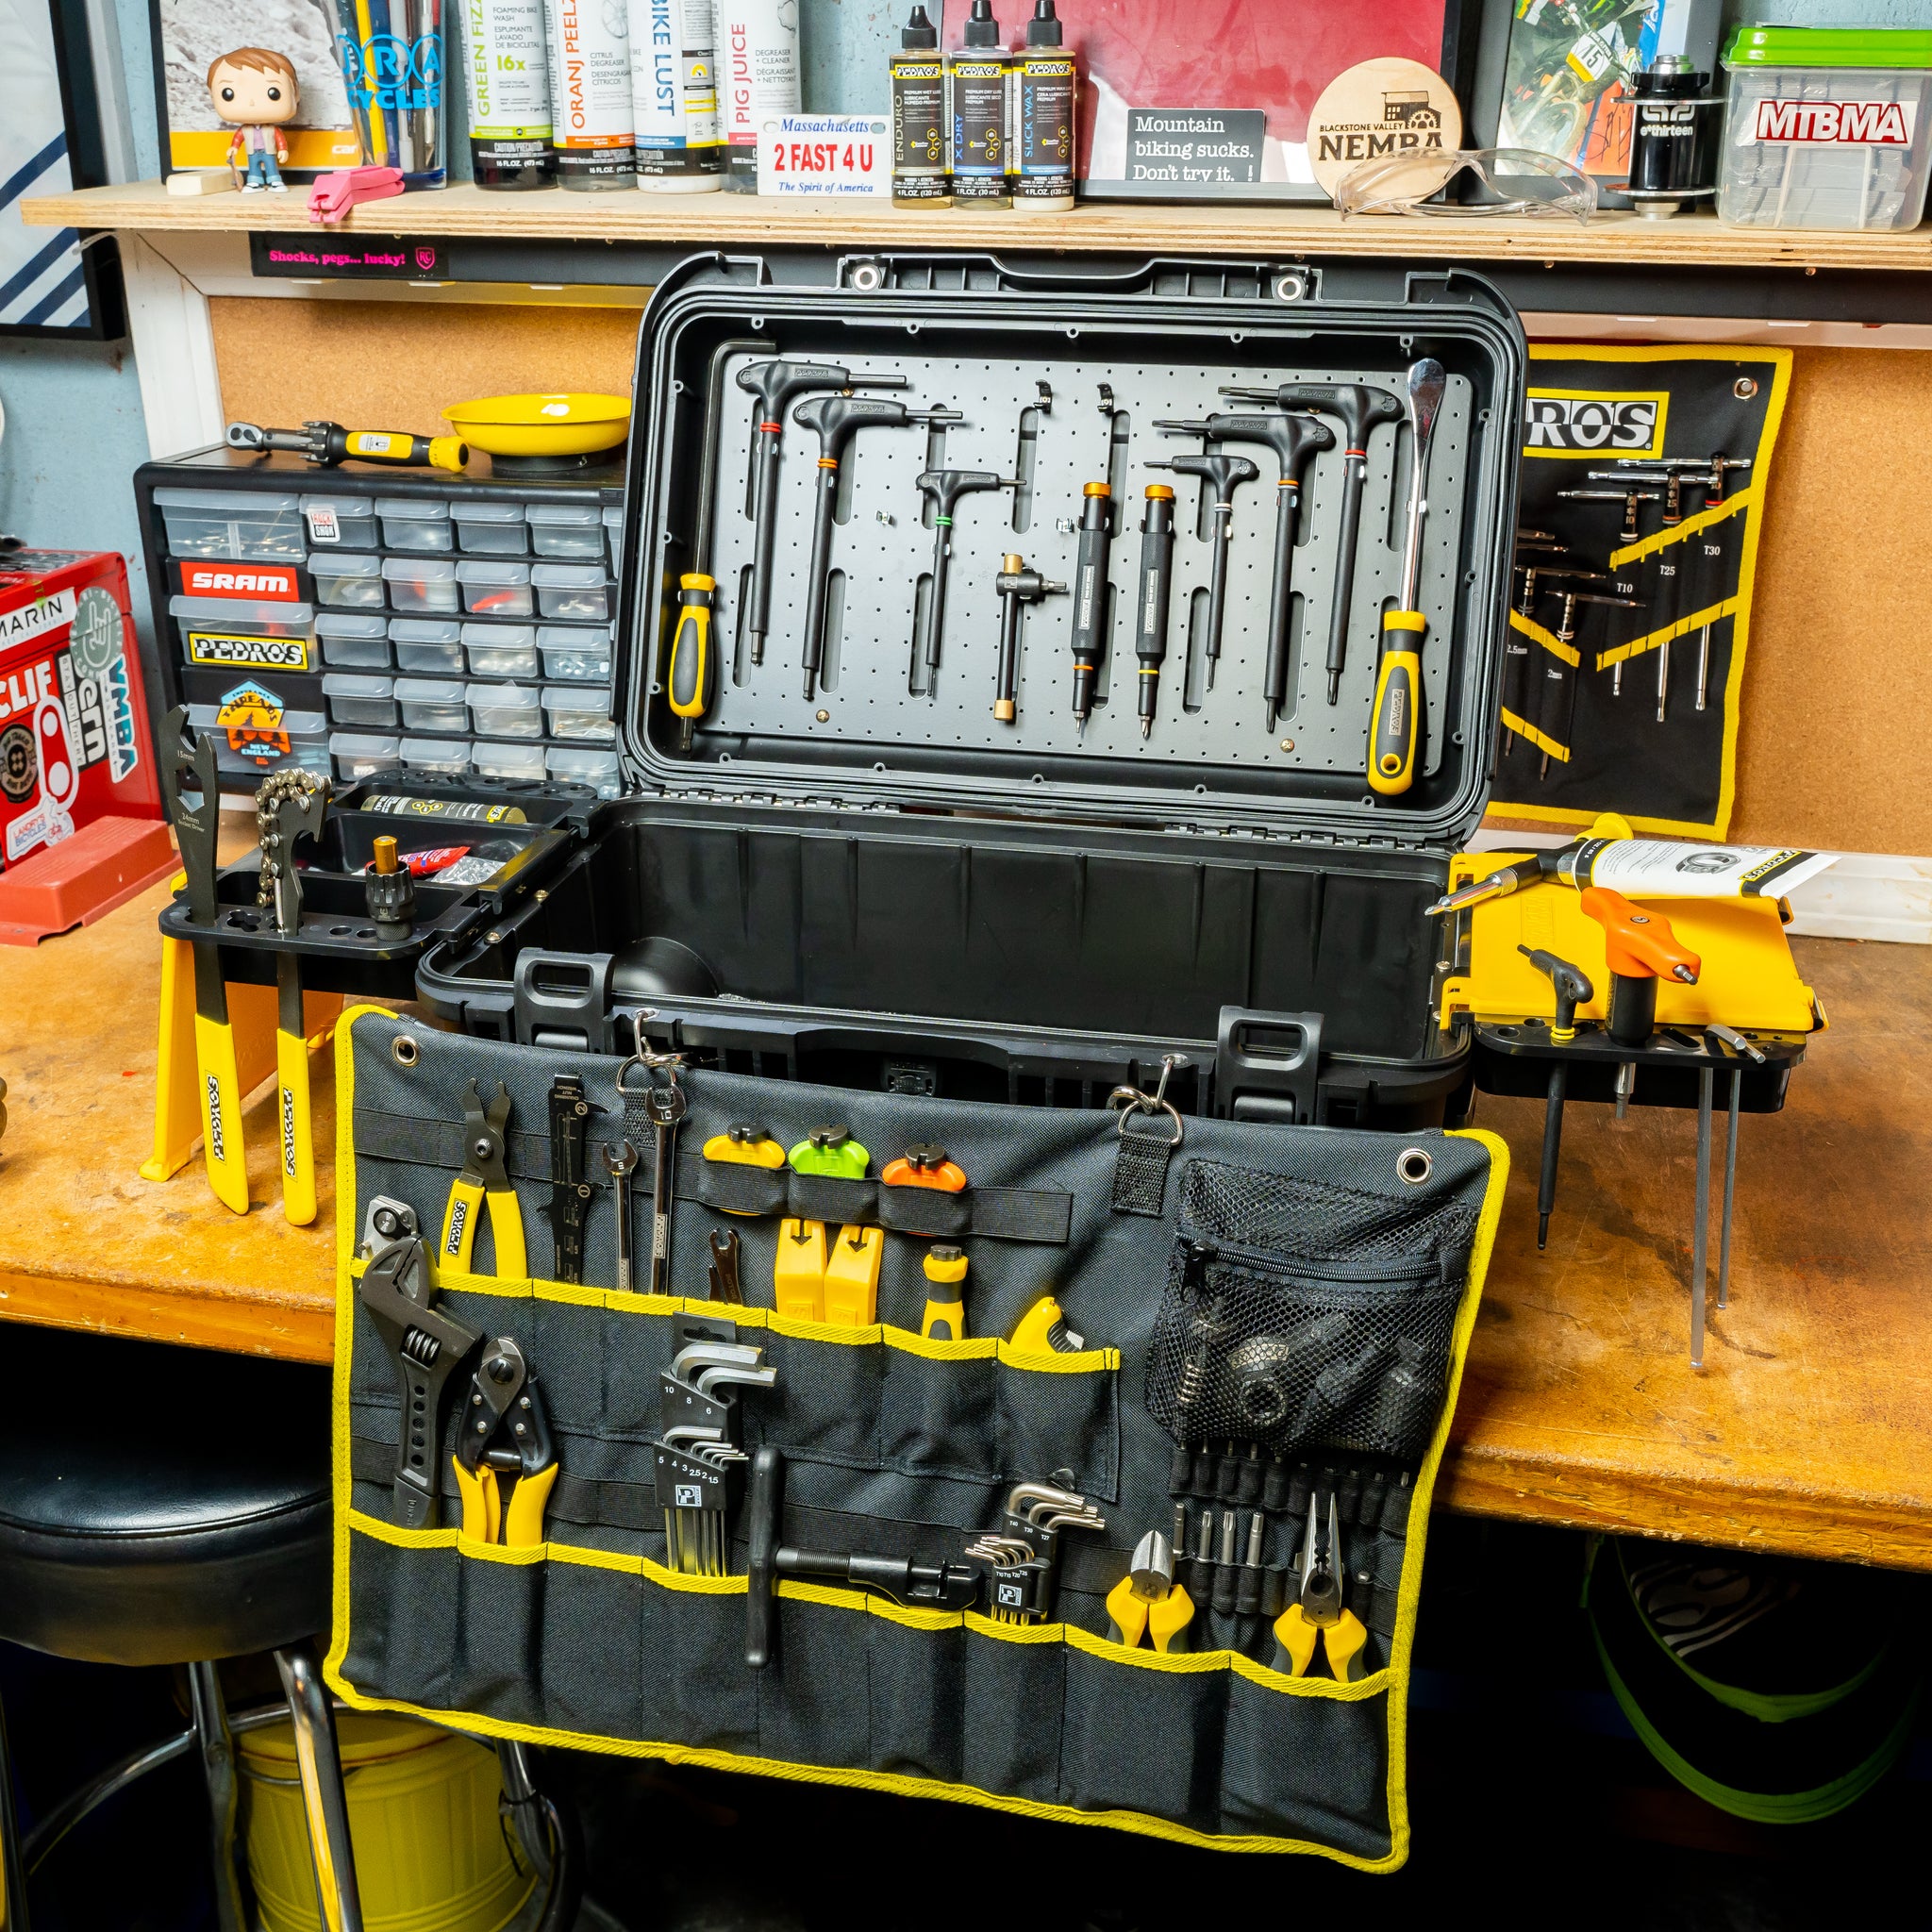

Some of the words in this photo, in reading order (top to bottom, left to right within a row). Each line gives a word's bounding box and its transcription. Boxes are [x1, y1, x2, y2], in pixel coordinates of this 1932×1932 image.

[562, 0, 580, 53] PEEL
[342, 46, 441, 75] JRA
[731, 24, 753, 83] JUICE
[1580, 44, 1603, 68] 15
[474, 44, 491, 116] GREEN
[655, 54, 675, 116] LUST
[347, 89, 441, 109] CYCLES
[567, 60, 586, 129] ORANJ
[735, 90, 751, 124] PIG
[1024, 85, 1033, 118] WAX
[780, 119, 870, 133] Massachusetts
[895, 95, 904, 161] ENDURO
[955, 115, 963, 144] DRY
[1135, 116, 1225, 133] Mountain
[1320, 125, 1372, 133] BLACKSTONE
[1373, 123, 1404, 132] VALLEY
[1756, 100, 1908, 144] MTBMA
[1024, 122, 1033, 158] SLICK
[1135, 141, 1192, 159] biking
[1196, 141, 1255, 158] sucks.
[774, 143, 785, 172] 2
[791, 143, 838, 172] FAST
[842, 143, 854, 172] 4
[859, 143, 873, 173] U
[955, 149, 963, 160] X
[1133, 165, 1181, 181] Don't
[1183, 166, 1214, 182] try
[1216, 166, 1235, 181] it.
[778, 182, 795, 192] The
[798, 182, 823, 193] Spirit
[824, 183, 835, 193] of
[837, 183, 874, 192] America
[269, 250, 320, 265] Shocks,
[321, 253, 362, 266] pegs...
[364, 252, 406, 266] lucky!
[1526, 398, 1657, 449] RO'S
[1704, 545, 1720, 555] T30
[192, 573, 289, 592] SRAM
[1660, 566, 1675, 575] T25
[1617, 583, 1633, 593] T10
[194, 638, 303, 665] PEDRO'S
[0, 660, 52, 719] CLIF
[68, 693, 76, 717] OUT
[109, 658, 135, 776] VMBA
[222, 695, 277, 722] THREADS
[77, 677, 106, 763] ern
[177, 749, 195, 762] 15mm
[182, 812, 200, 824] 24mm
[207, 1074, 225, 1162] PEDRO'S
[661, 1110, 672, 1120] 10
[283, 1087, 296, 1178] PEDRO'S
[446, 1199, 468, 1255] PEDRO'S
[664, 1386, 675, 1394] 10
[706, 1407, 712, 1415] 6
